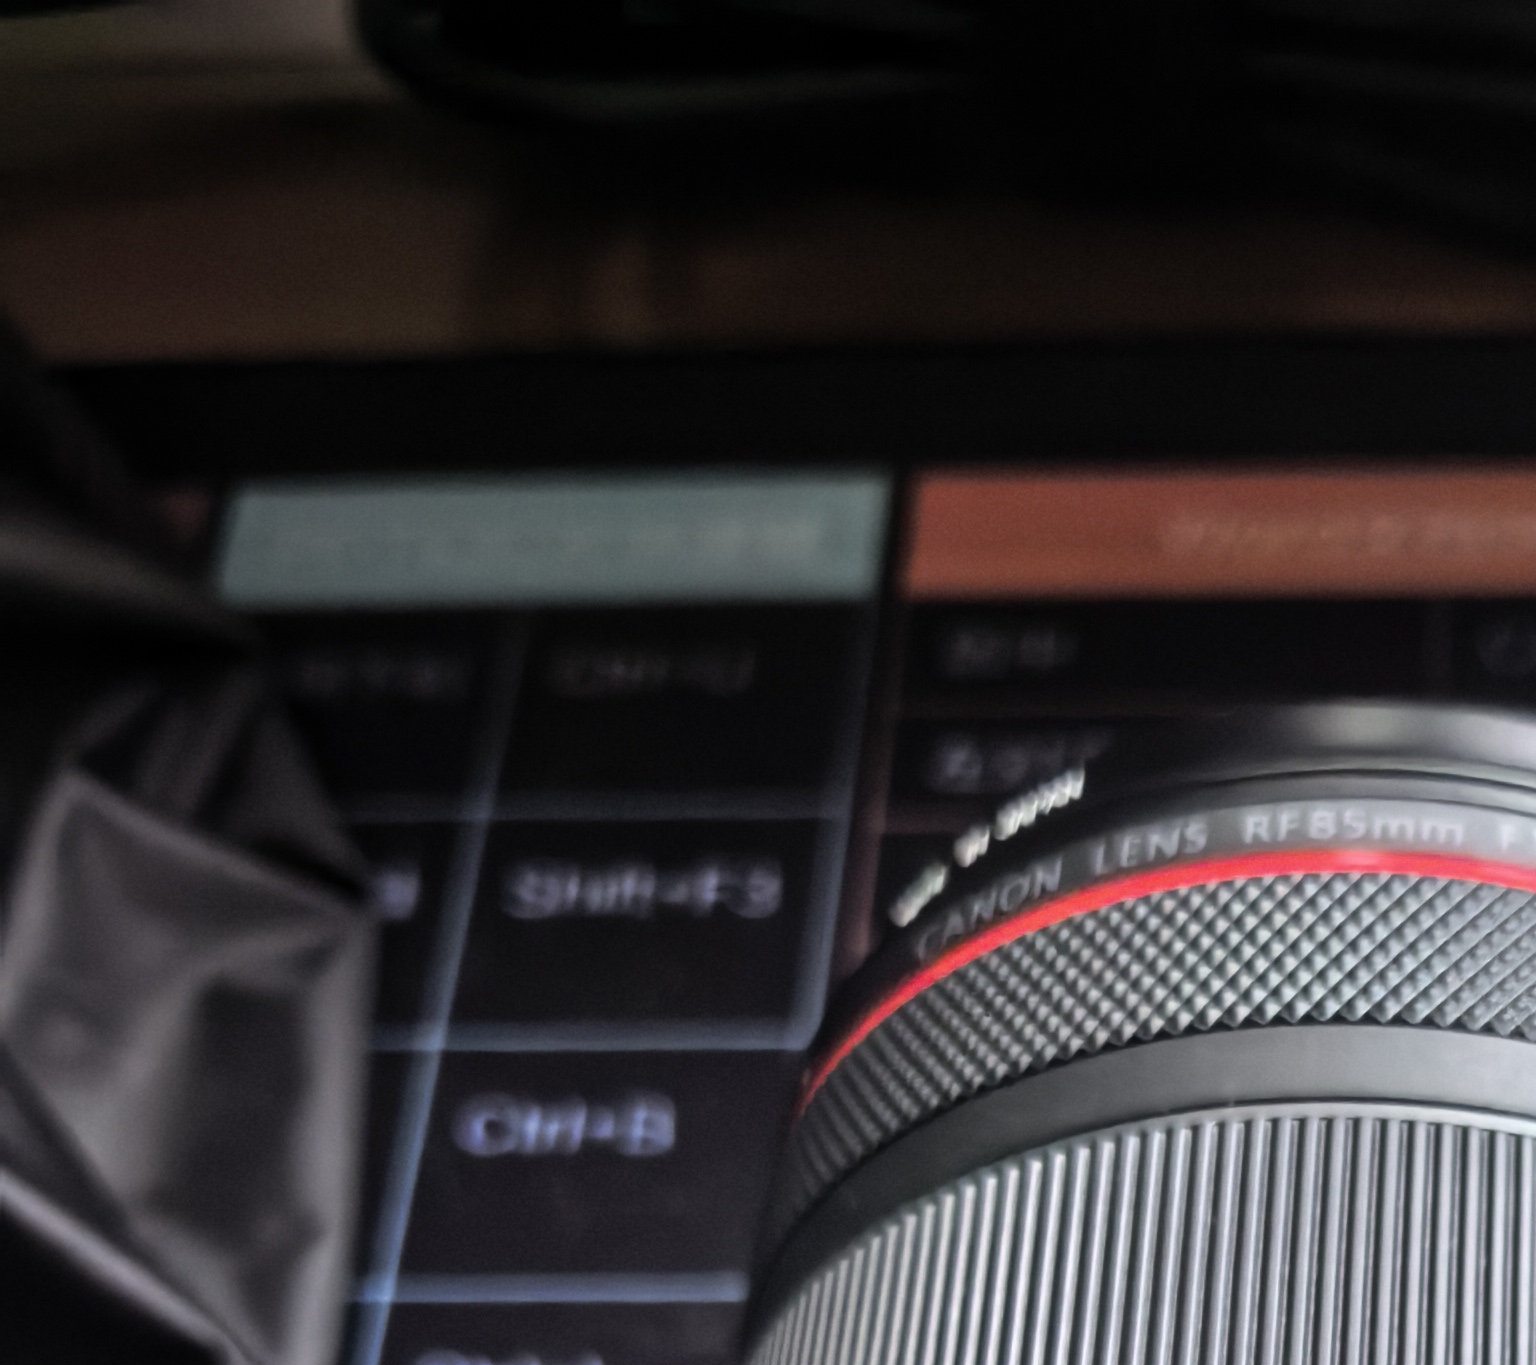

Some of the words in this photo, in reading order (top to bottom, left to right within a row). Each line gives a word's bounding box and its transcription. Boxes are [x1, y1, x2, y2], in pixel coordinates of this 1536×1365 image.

[918, 857, 1063, 962] CANON
[1093, 816, 1209, 875] LENS
[1243, 806, 1463, 846] RF85mm
[456, 1095, 679, 1158] Ctrl+B
